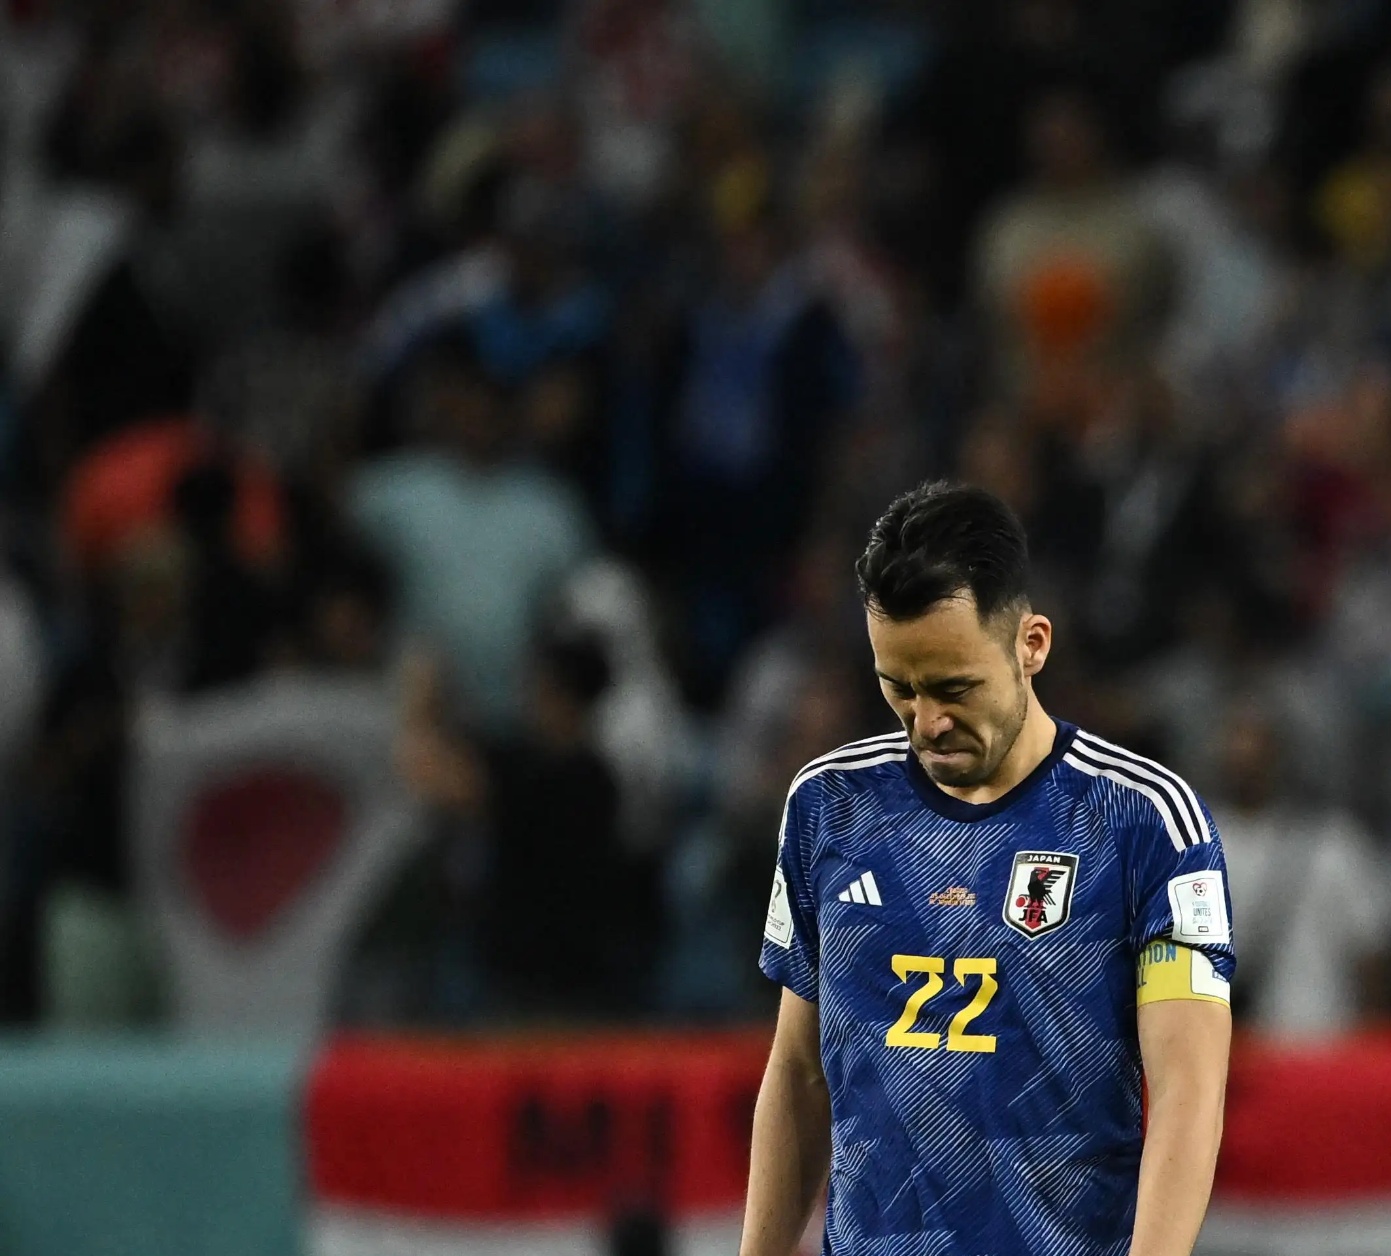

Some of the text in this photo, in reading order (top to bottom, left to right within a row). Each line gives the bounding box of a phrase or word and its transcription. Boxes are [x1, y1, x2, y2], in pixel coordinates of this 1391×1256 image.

[1028, 854, 1061, 863] JAPAN
[1019, 908, 1048, 923] JFA
[885, 954, 999, 1053] 22
